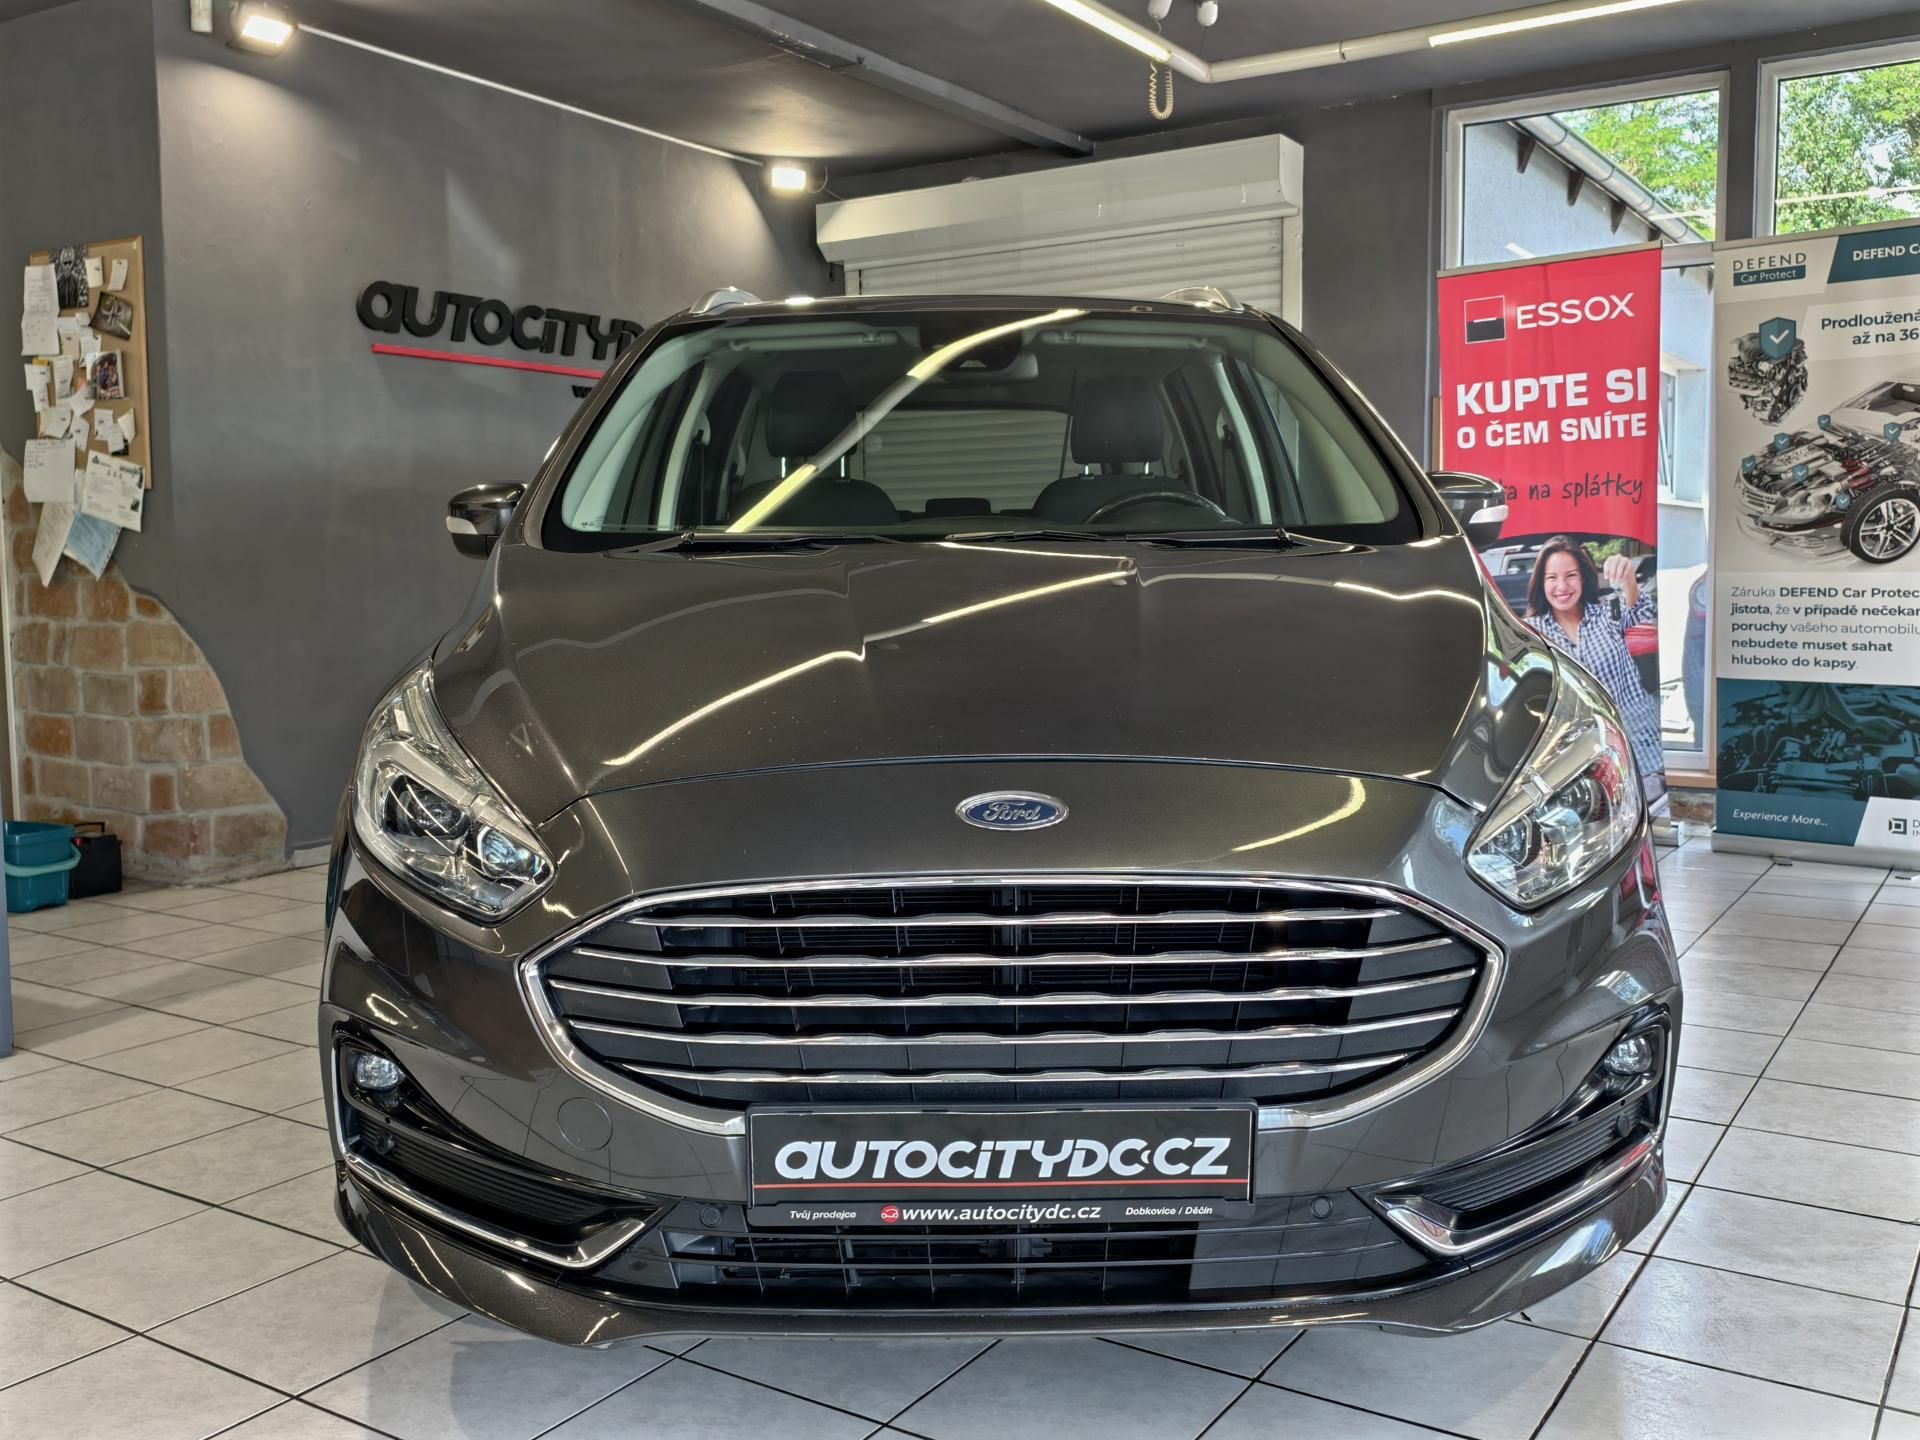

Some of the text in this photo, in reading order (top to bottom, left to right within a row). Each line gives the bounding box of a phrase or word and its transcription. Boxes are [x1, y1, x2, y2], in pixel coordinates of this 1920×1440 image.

[1853, 243, 1920, 261] DEFEND C
[1733, 252, 1807, 271] DEFEND
[1740, 269, 1797, 284] Car Protect
[1516, 292, 1635, 330] ESSOX
[1852, 328, 1920, 345] až na 36
[1456, 367, 1647, 416] KUPTE SI
[1456, 411, 1647, 449] O ČEM SNÍTE
[1529, 483, 1551, 501] na
[1561, 471, 1643, 507] splátky
[1731, 586, 1776, 598] Záruka
[1780, 587, 1838, 598] DEFEND
[1842, 587, 1867, 598] Car
[1730, 602, 1773, 616] jistota,
[1776, 604, 1790, 615] že
[1793, 606, 1801, 615] v
[1804, 604, 1858, 617] případě
[1731, 622, 1788, 634] poruchy
[1790, 622, 1838, 633] vašeho
[1731, 638, 1893, 652] nebudete muset sahat
[1731, 654, 1859, 671] hluboko do kapsy.
[982, 801, 1041, 821] Ford
[1732, 809, 1789, 823] Experience
[790, 1210, 857, 1221] Tvůj prodejce
[902, 1203, 1102, 1223] www.autocitydc.cz
[1125, 1206, 1176, 1216] Dobkovice
[1185, 1206, 1213, 1215] Děčín
